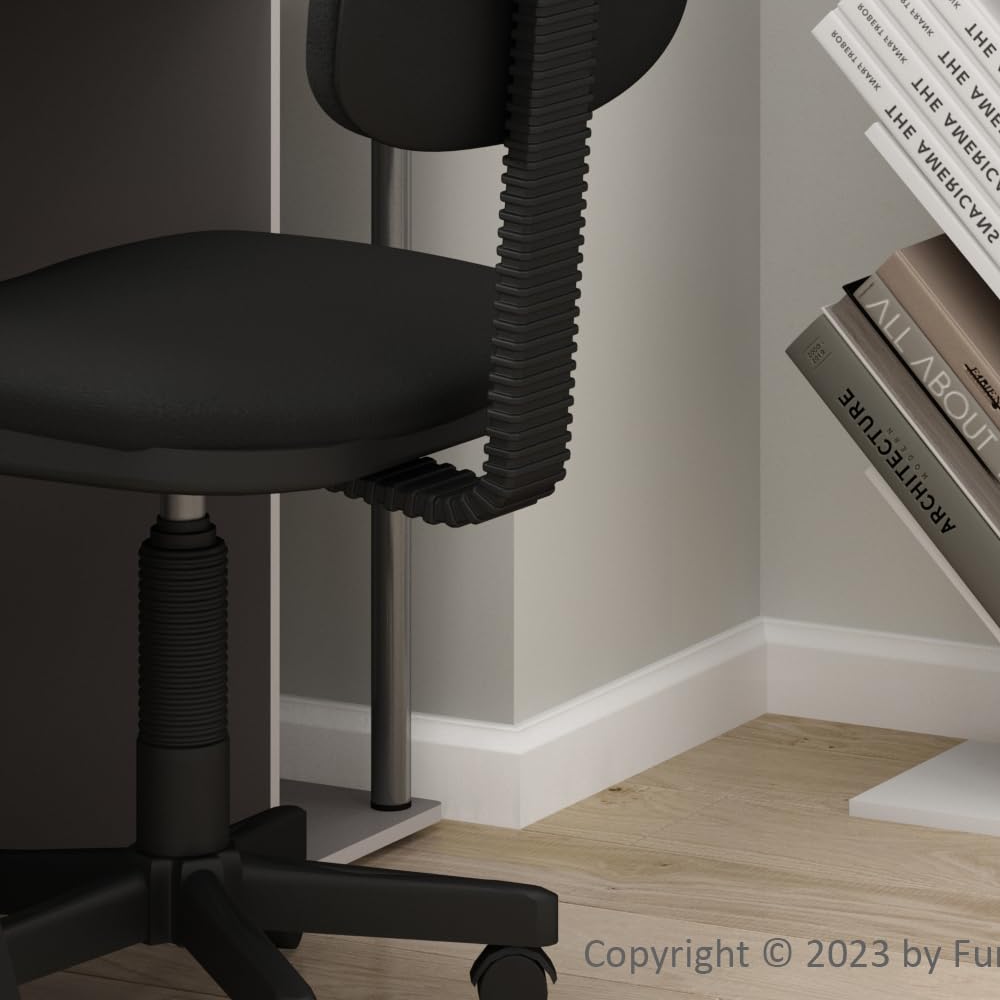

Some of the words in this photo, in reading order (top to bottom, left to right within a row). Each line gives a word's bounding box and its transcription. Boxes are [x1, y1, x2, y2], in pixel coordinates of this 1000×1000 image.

[866, 299, 911, 354] ALL
[911, 356, 998, 452] ABOUT
[838, 388, 955, 534] ARCHITECTURE
